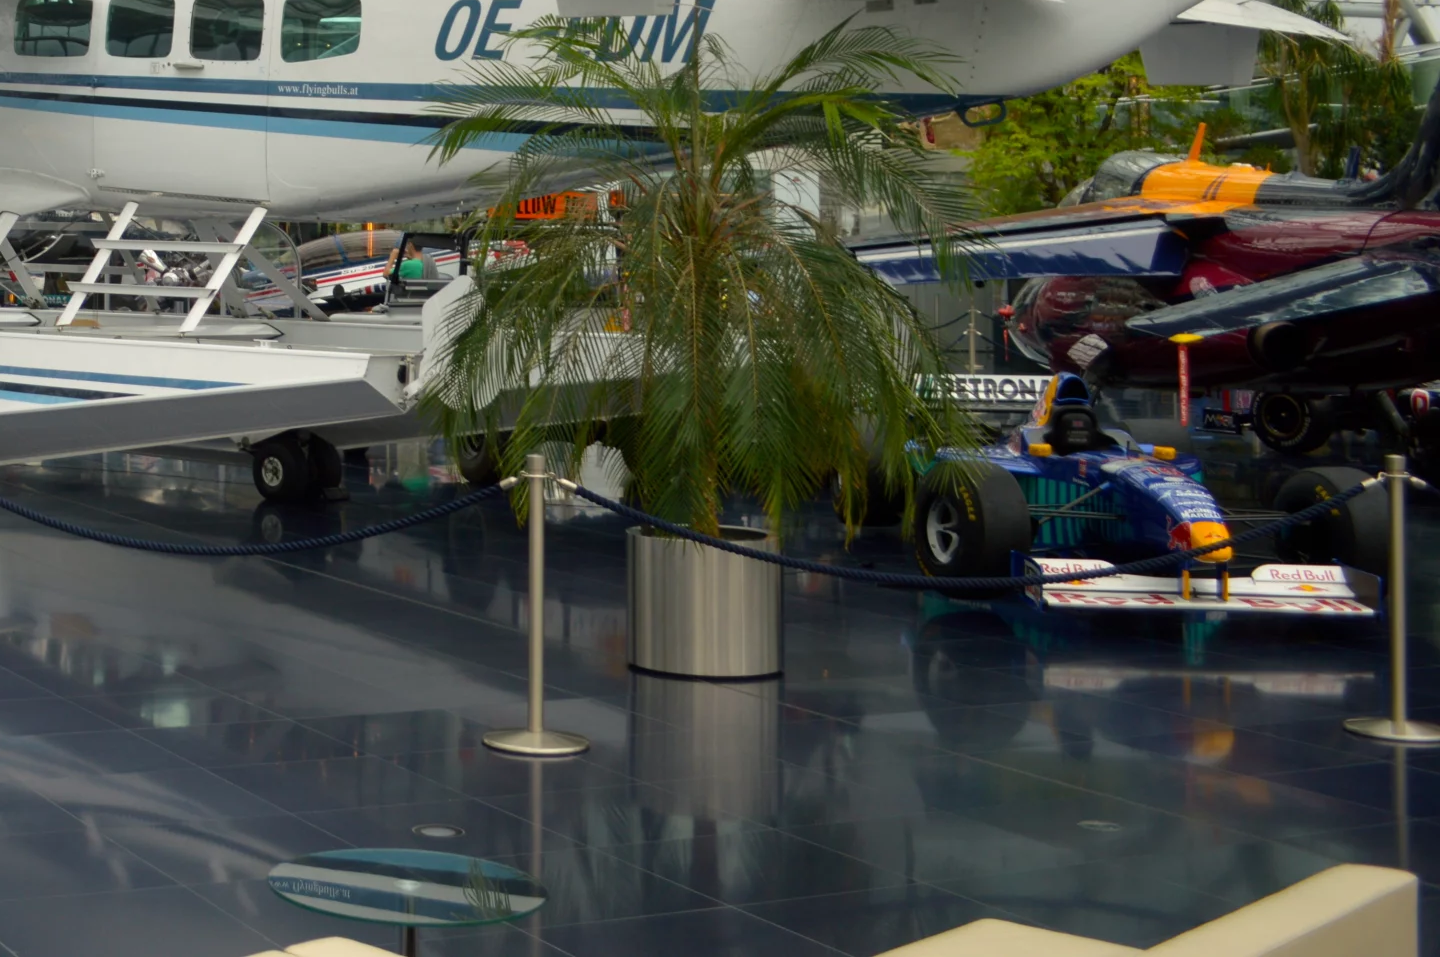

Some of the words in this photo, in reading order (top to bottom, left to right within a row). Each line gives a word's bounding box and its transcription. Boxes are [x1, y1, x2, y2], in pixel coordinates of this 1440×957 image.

[277, 83, 359, 96] www.flyingbulls.at
[1040, 562, 1071, 574] Red
[1269, 568, 1296, 581] Red
[1297, 569, 1336, 582] Bull
[1049, 592, 1175, 605] Red
[1237, 597, 1364, 612] Bull
